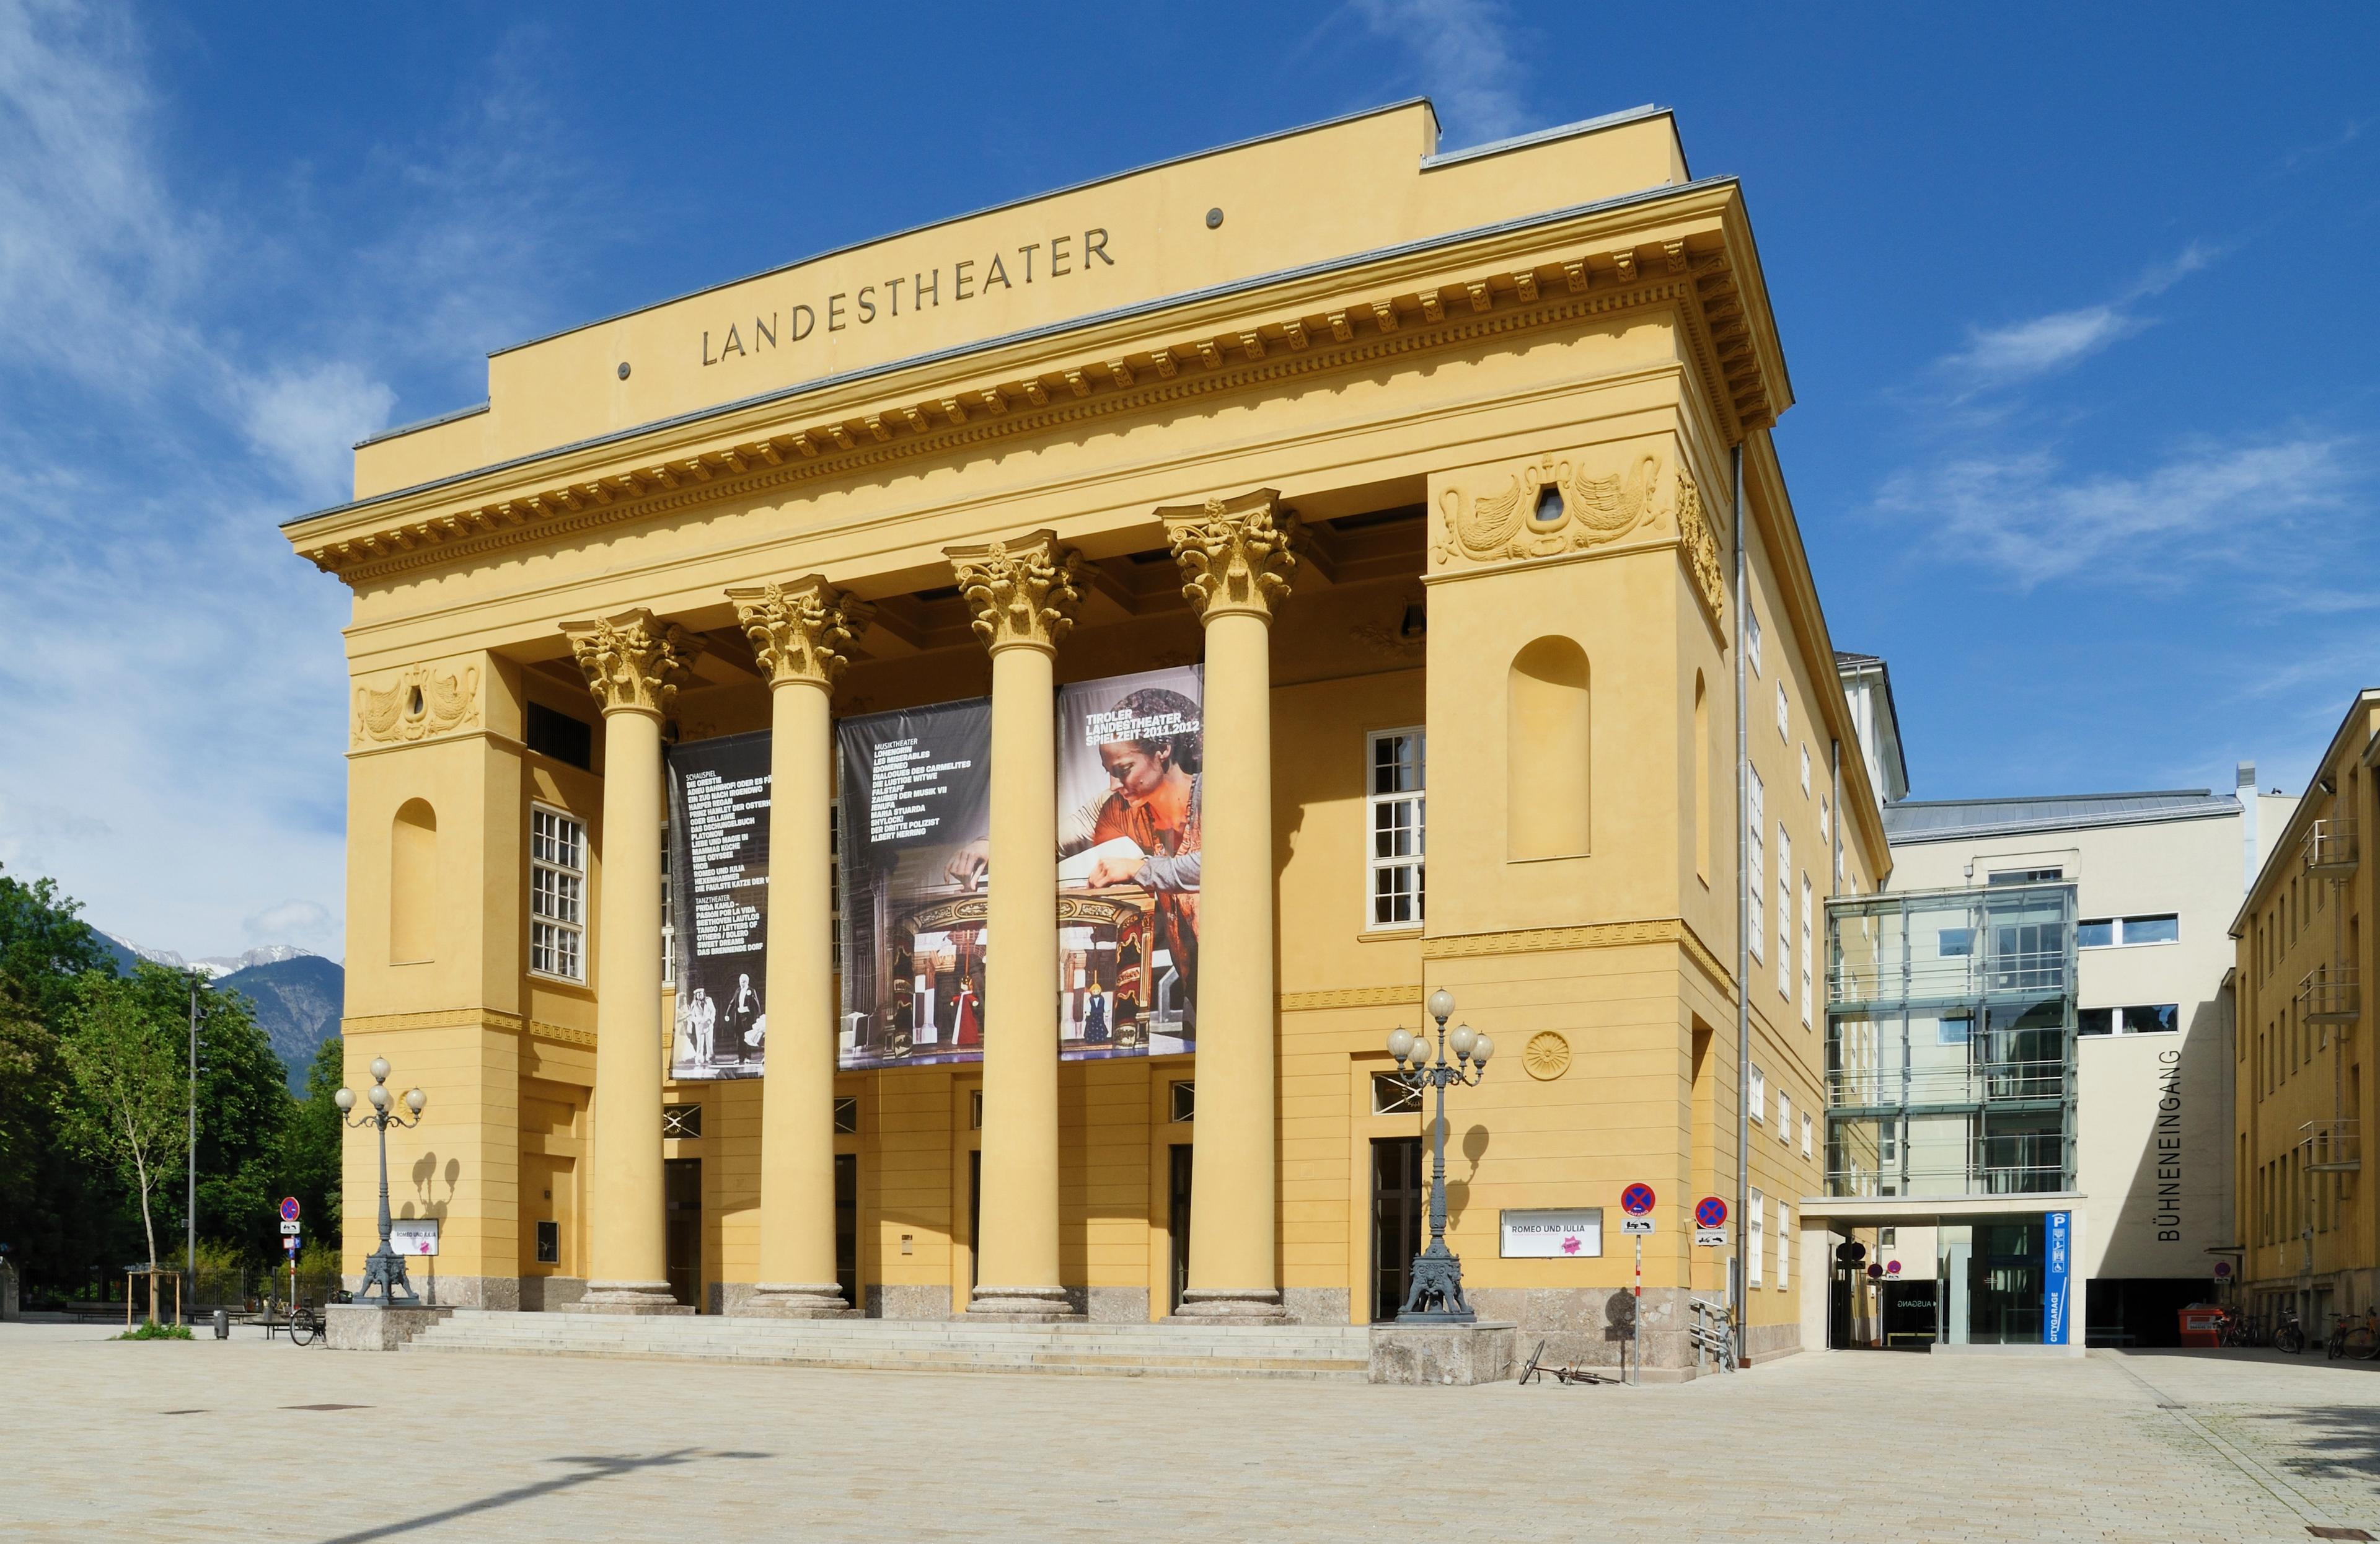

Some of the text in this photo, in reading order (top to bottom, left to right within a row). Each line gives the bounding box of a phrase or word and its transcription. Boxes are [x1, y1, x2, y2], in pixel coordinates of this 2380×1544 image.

[702, 227, 1114, 367] LANDESTHEATER
[1086, 709, 1132, 725] TIROLER
[1086, 713, 1181, 736] LANDESTHEATER
[1086, 720, 1200, 746] SPIELZEIT 2011.2012
[875, 738, 918, 751] MUSIKTHEATER
[875, 746, 912, 758] LOHENGRIN
[873, 762, 908, 774] IDOMENEO
[873, 769, 910, 781] DIALOGUES
[926, 761, 971, 772] CARMELITES
[685, 770, 716, 781] SCHAUSPIEL
[697, 776, 721, 787] ORESTIE
[884, 777, 912, 787] LUSTIGE
[913, 772, 938, 782] WITWE
[687, 787, 704, 796] ADIEU
[736, 779, 754, 787] ODER
[699, 793, 710, 802] ZUG
[712, 791, 729, 800] NACH
[729, 785, 763, 796] IRGENDWO
[872, 785, 904, 796] FALSTAFF
[871, 793, 898, 803] ZAUBER
[899, 791, 912, 800] DER
[914, 788, 936, 797] MUSIK
[689, 798, 733, 811] HARPER REGAN
[689, 809, 707, 818] PRINZ
[707, 806, 731, 816] HAMLET
[733, 803, 745, 811] DER
[871, 805, 925, 819] MARIA STUARDA
[690, 813, 735, 826] ODER SELLAWIE
[703, 817, 755, 831] DSCHUNGELBUCH
[884, 823, 908, 832] DRITTE
[909, 818, 940, 829] POLIZIST
[691, 829, 724, 840] PLATONOW
[692, 840, 708, 848] LIEBE
[721, 834, 741, 844] MAGIE
[871, 828, 926, 842] ALBERT HERRING
[692, 845, 720, 855] MAMMAS
[692, 850, 734, 863] EINE ODYSSEE
[693, 862, 708, 870] HIOB
[694, 864, 745, 878] ROMEO UND JULIA
[694, 873, 740, 885] HEXENHAMMER
[706, 881, 731, 891] FAULSTE
[732, 879, 751, 888] KATZE
[695, 894, 730, 904] TANZTHEATER
[695, 904, 714, 912] FRIDA
[714, 901, 734, 910] KAHLO
[720, 909, 732, 917] POR
[697, 914, 760, 926] BEETHOVEN LAUTLOS
[723, 922, 749, 931] LETTERS
[697, 932, 721, 941] OTHERS
[726, 930, 749, 938] BOLERO
[719, 937, 744, 946] DREAMS
[711, 945, 747, 955] BRENNENDE
[747, 942, 764, 951] DORF
[2153, 1050, 2181, 1242] BÜHNENEINGANG
[2054, 1217, 2065, 1227] P
[2050, 1292, 2058, 1342] CITYGARAGE
